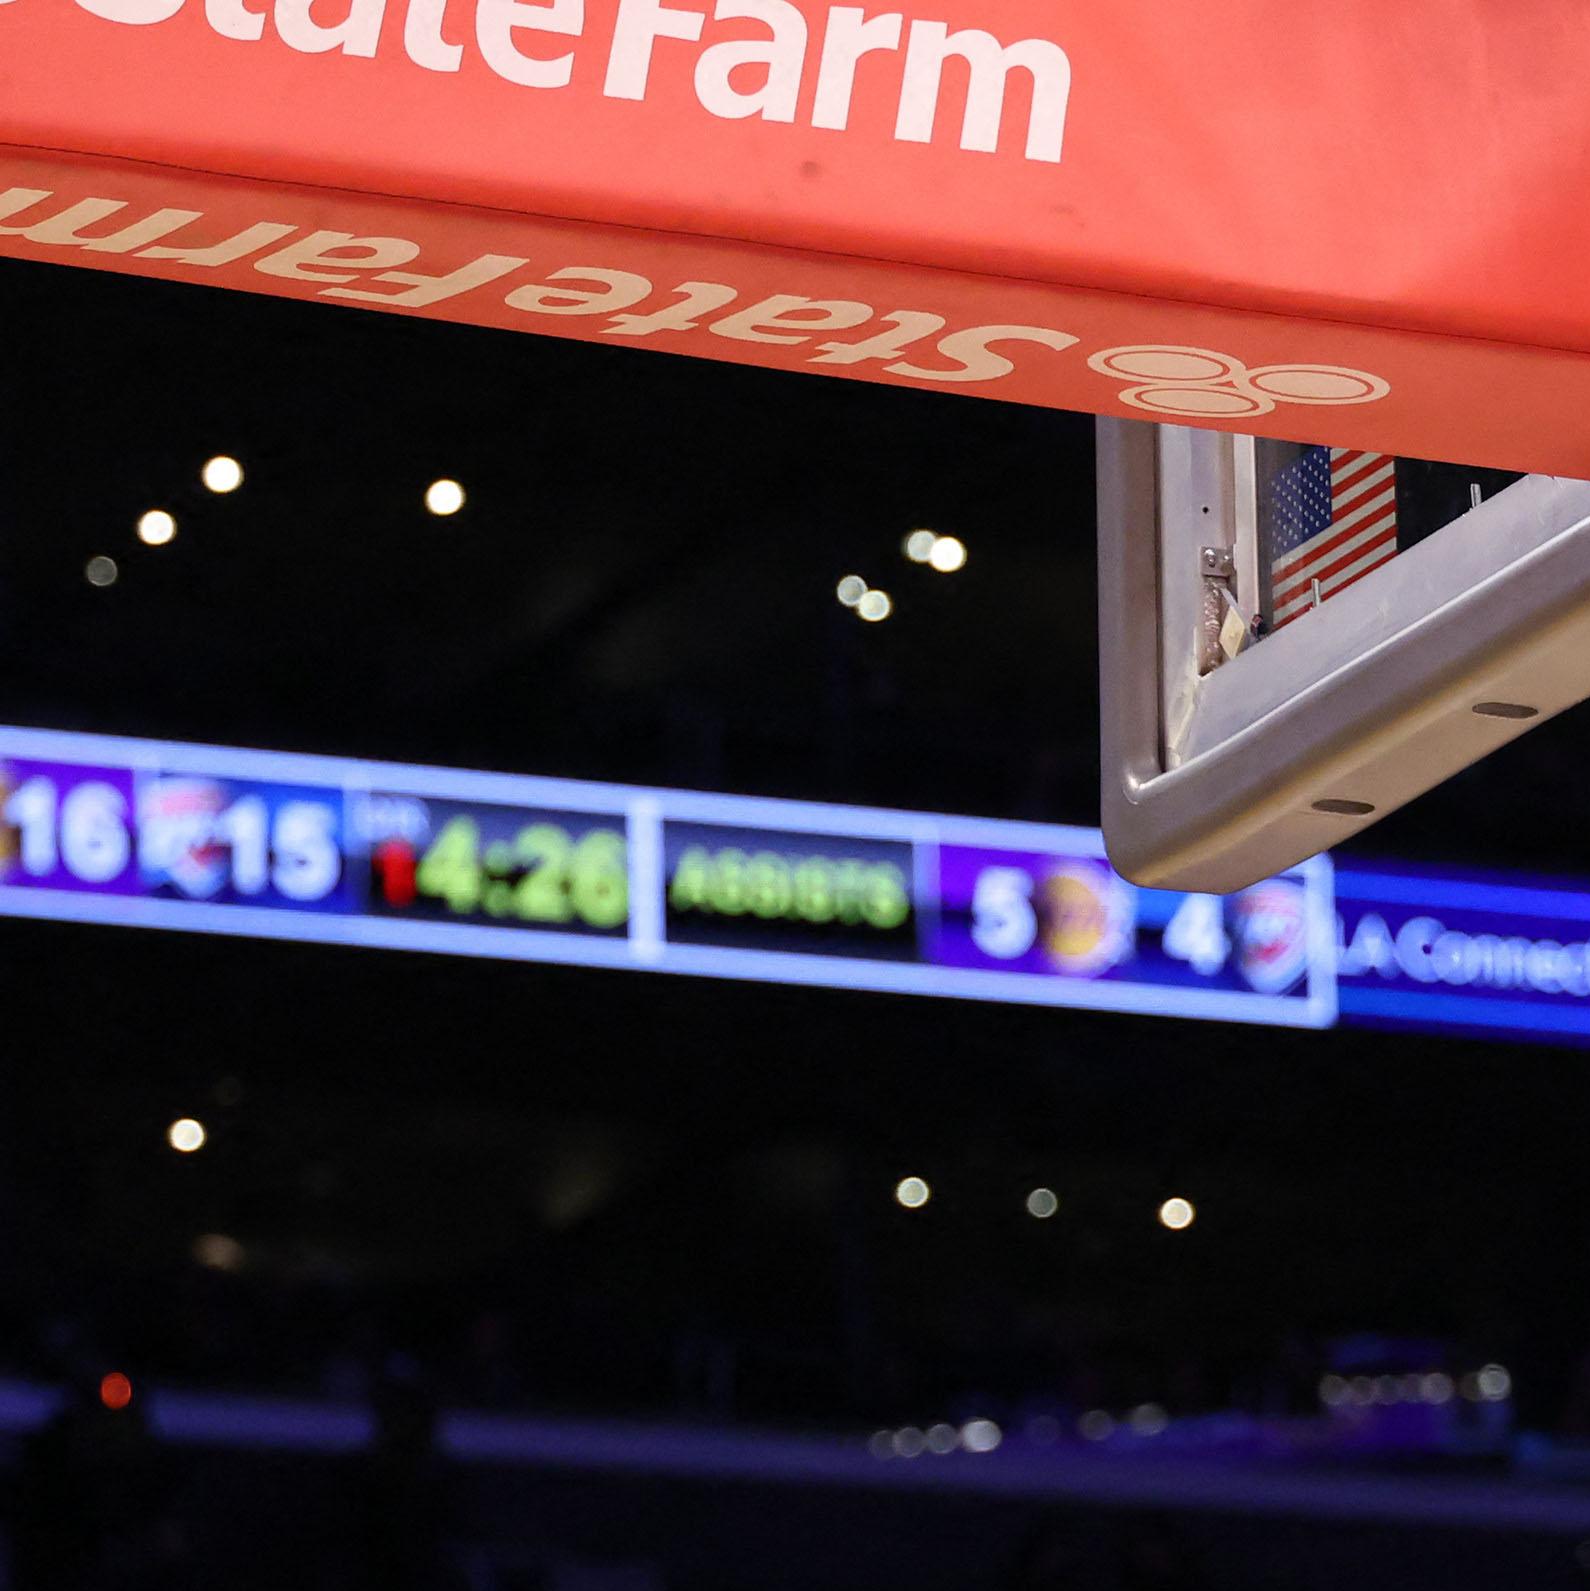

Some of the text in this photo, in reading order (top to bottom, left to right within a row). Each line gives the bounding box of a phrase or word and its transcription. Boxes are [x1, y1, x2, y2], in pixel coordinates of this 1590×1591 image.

[6, 773, 131, 883] 16
[222, 794, 342, 901] 15
[415, 814, 628, 928] 4:26
[971, 866, 1038, 960] 5
[1162, 893, 1232, 975] 4
